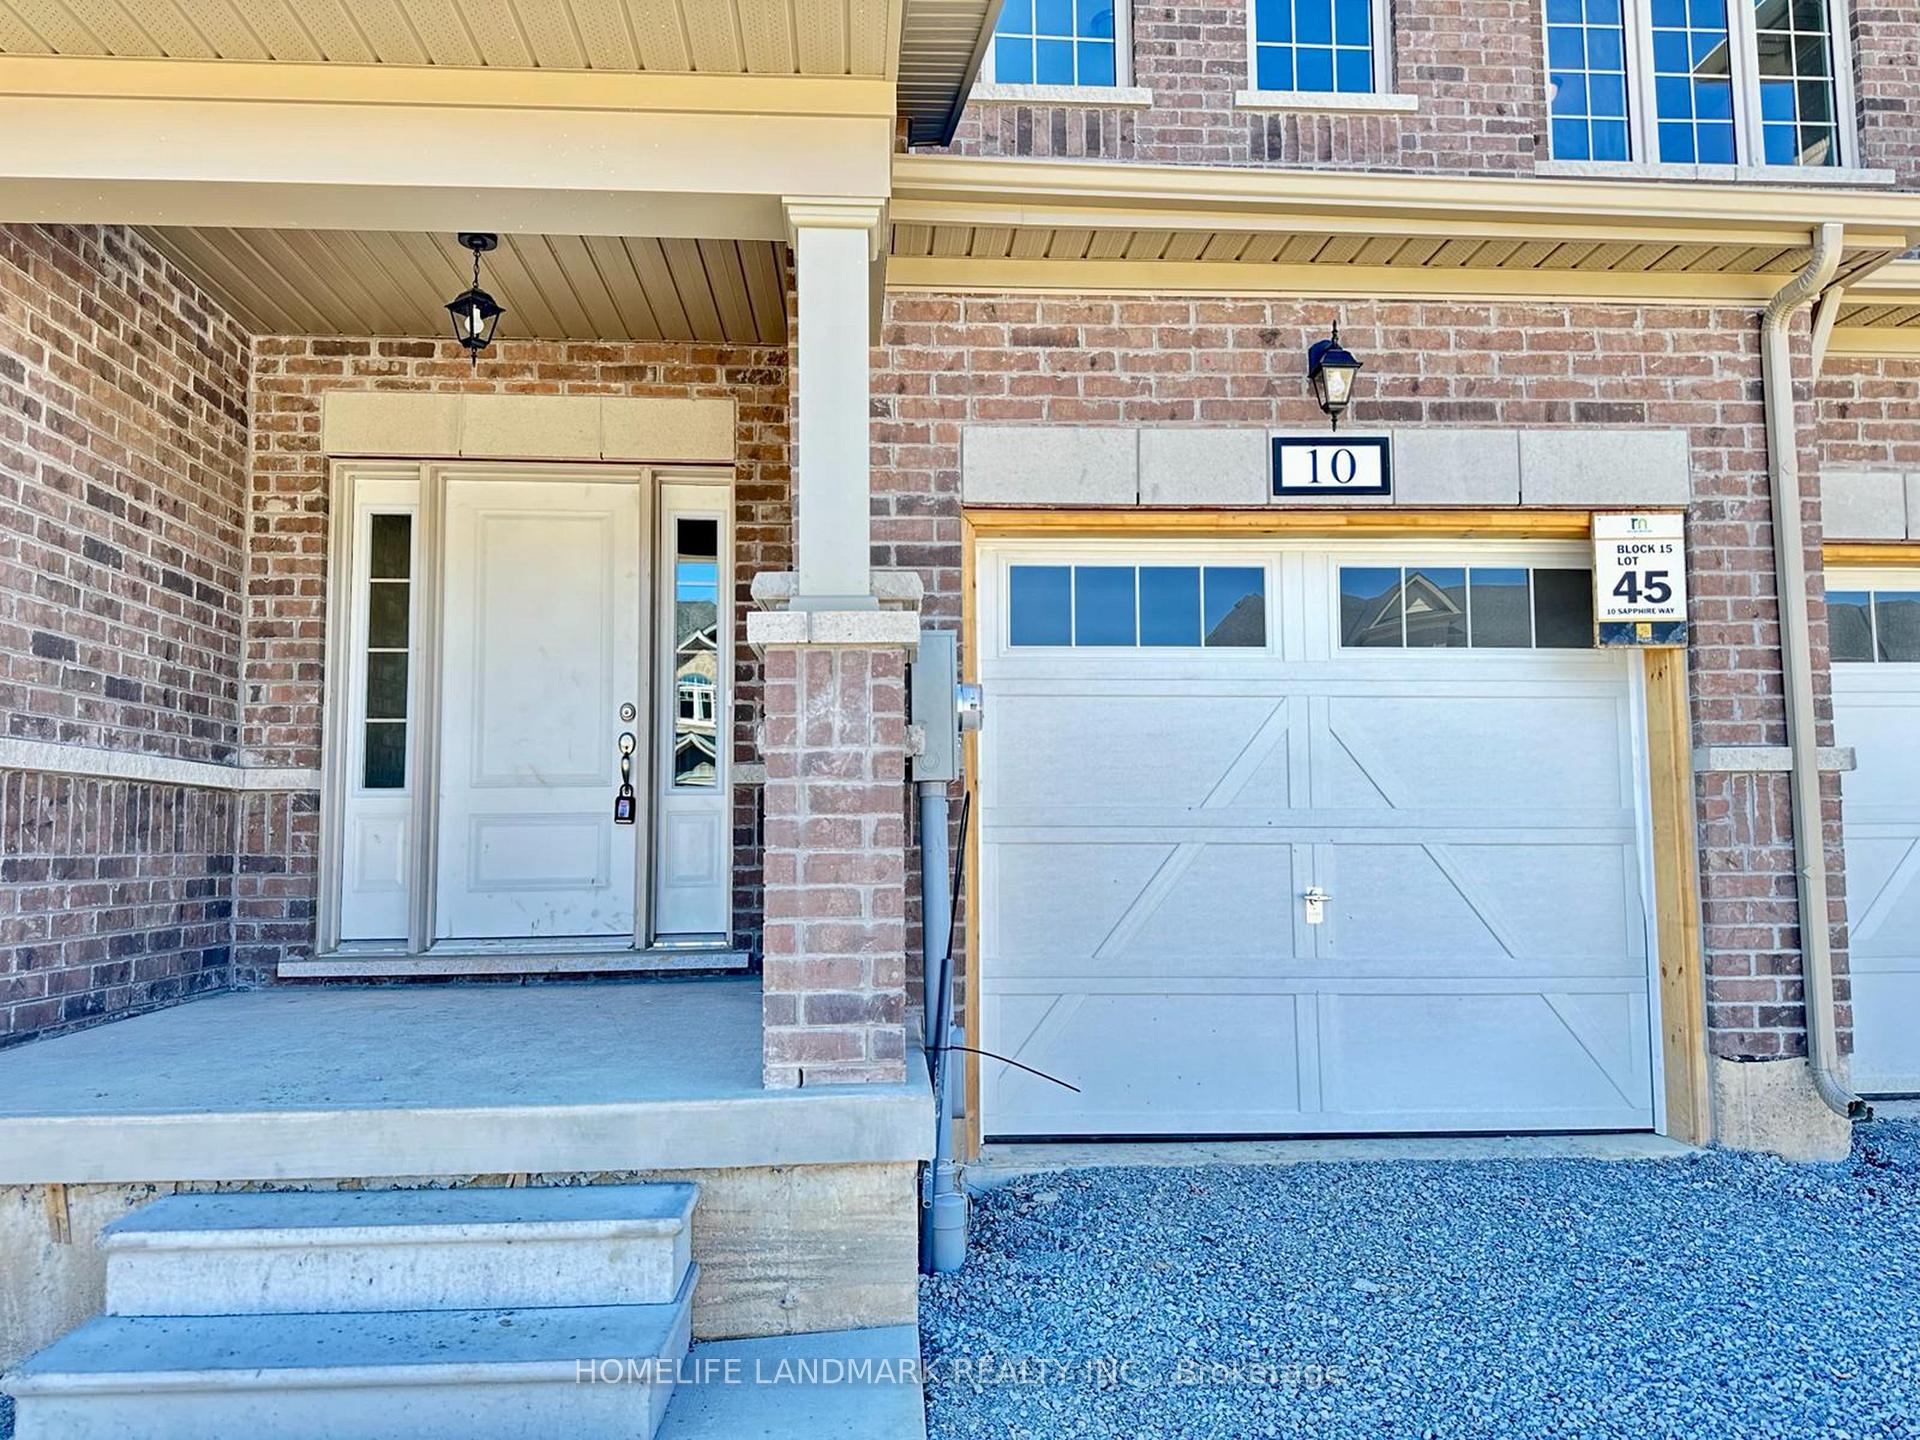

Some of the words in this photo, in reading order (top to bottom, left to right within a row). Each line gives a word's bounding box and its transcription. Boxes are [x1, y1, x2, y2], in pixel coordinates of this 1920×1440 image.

[1307, 448, 1356, 484] 10
[1617, 544, 1656, 554] BLOCK
[1660, 544, 1673, 553] 15
[1617, 556, 1639, 566] LOT
[1612, 570, 1672, 604] 45
